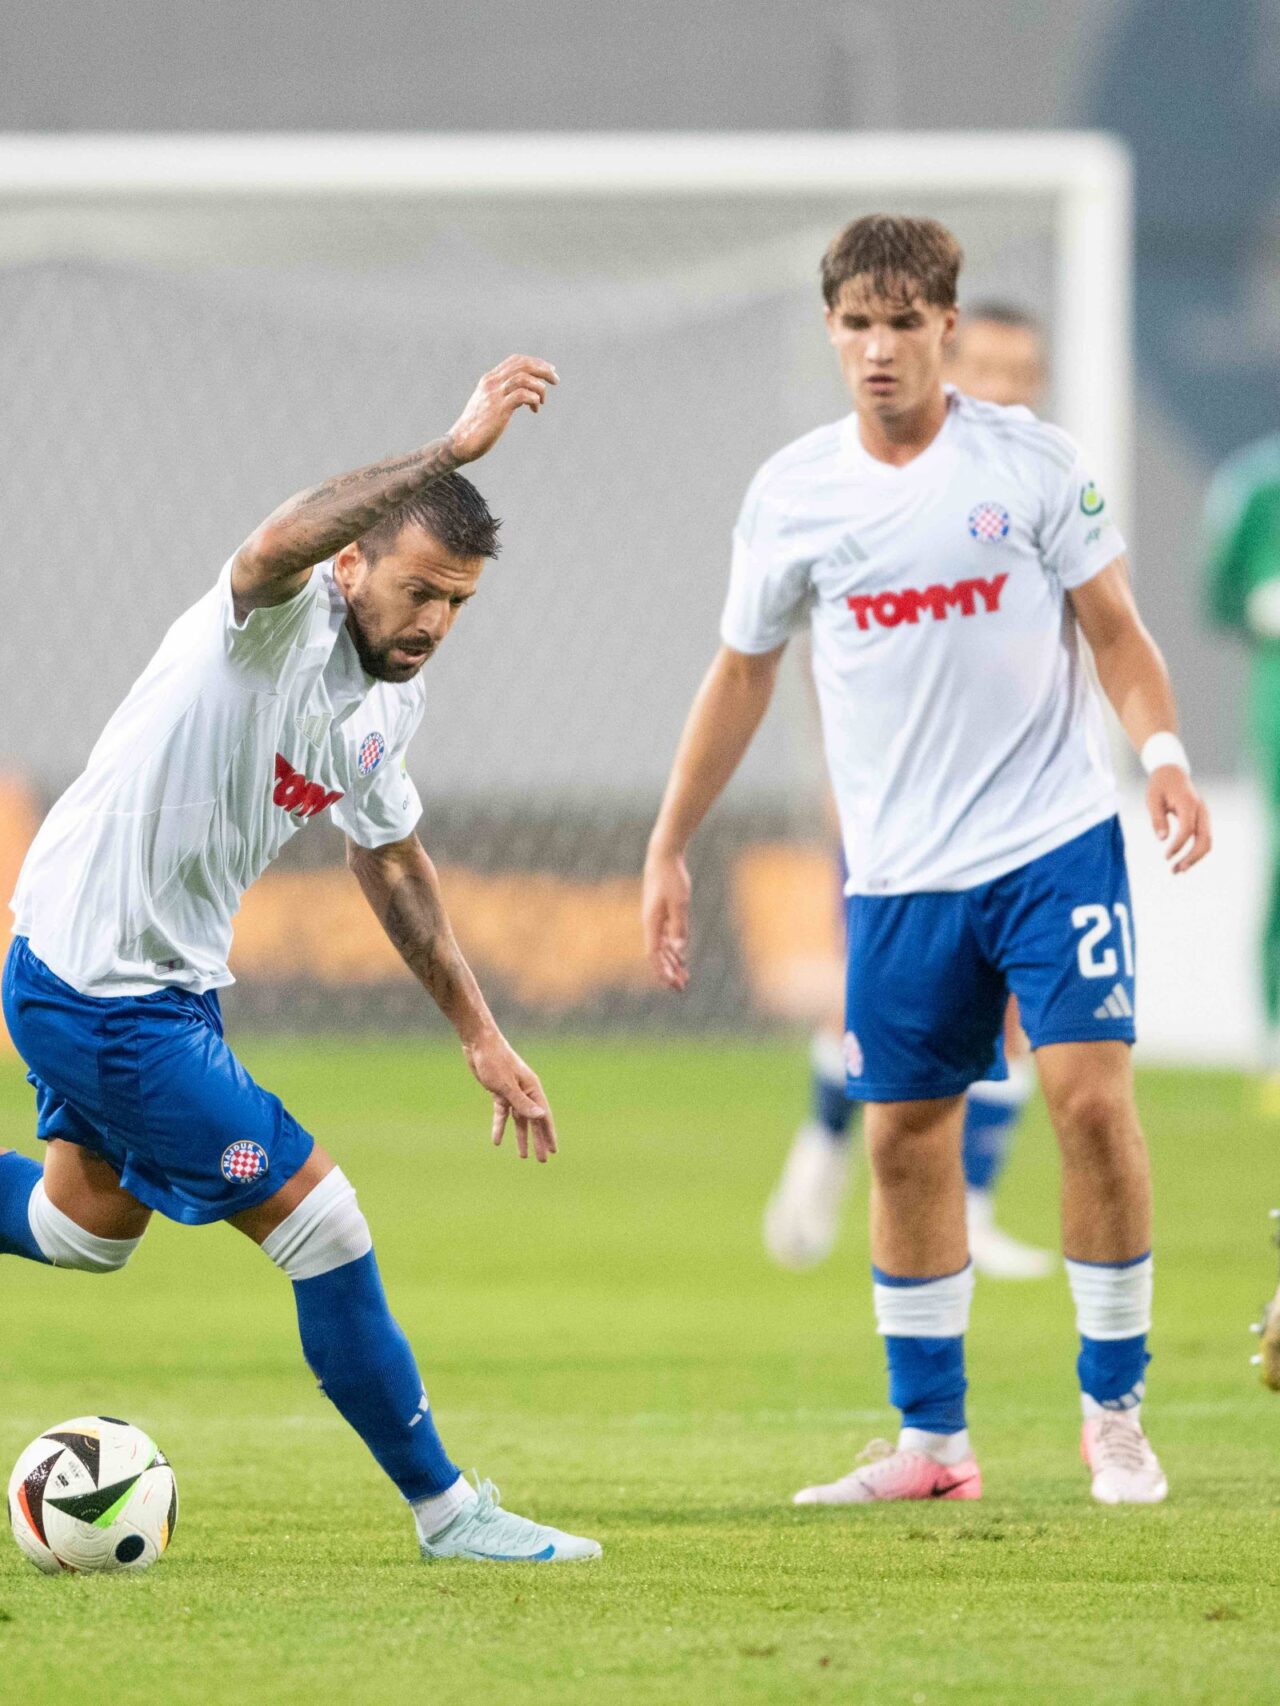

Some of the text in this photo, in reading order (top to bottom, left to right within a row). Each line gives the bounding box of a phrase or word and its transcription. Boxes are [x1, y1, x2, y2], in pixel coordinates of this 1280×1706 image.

[847, 573, 1009, 630] TOMMY
[1072, 902, 1135, 980] 21
[224, 1143, 254, 1167] HAJDUK
